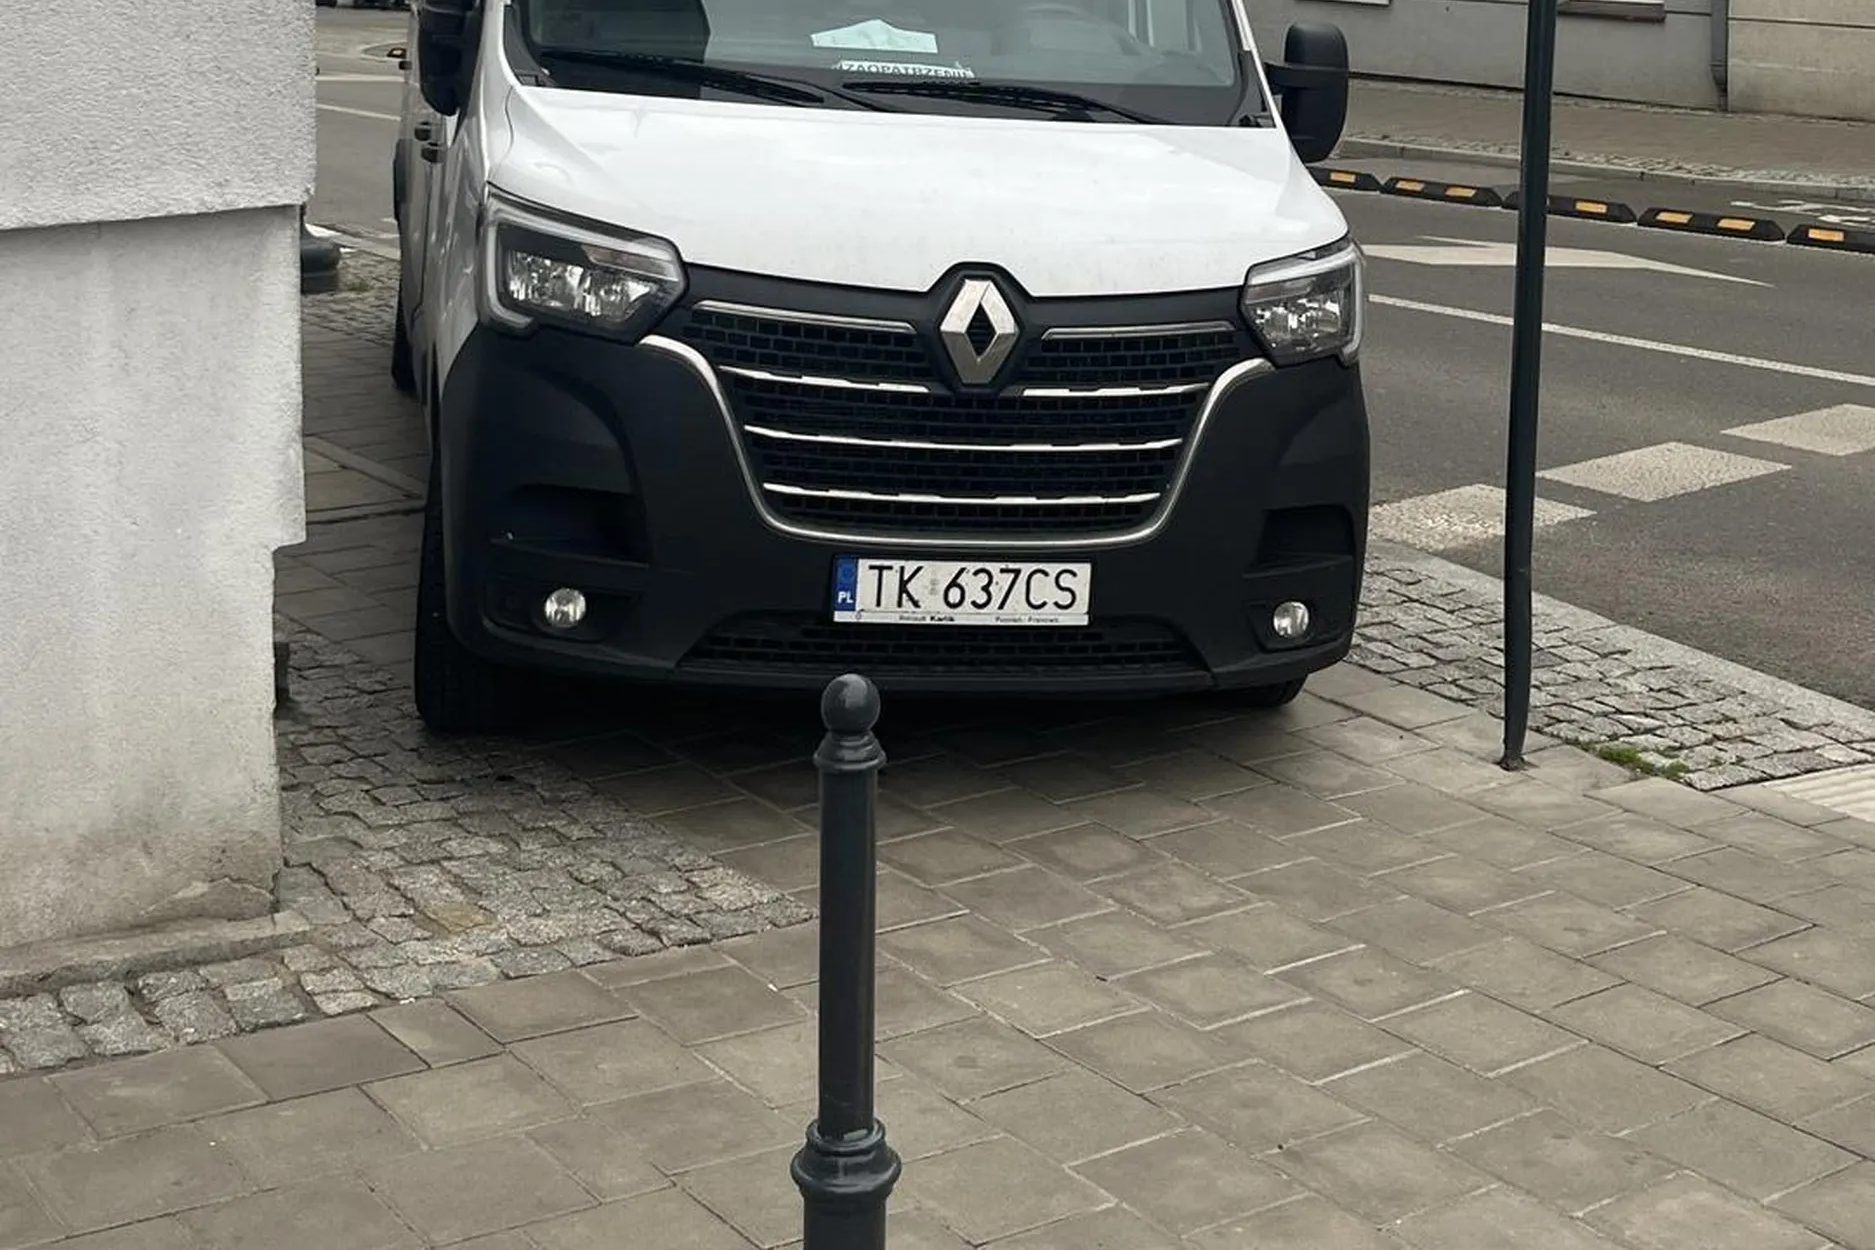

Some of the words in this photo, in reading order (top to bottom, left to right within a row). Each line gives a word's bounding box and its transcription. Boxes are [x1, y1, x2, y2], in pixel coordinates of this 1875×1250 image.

[837, 590, 854, 604] PL
[868, 565, 924, 609] TK
[943, 567, 1078, 611] 637CS
